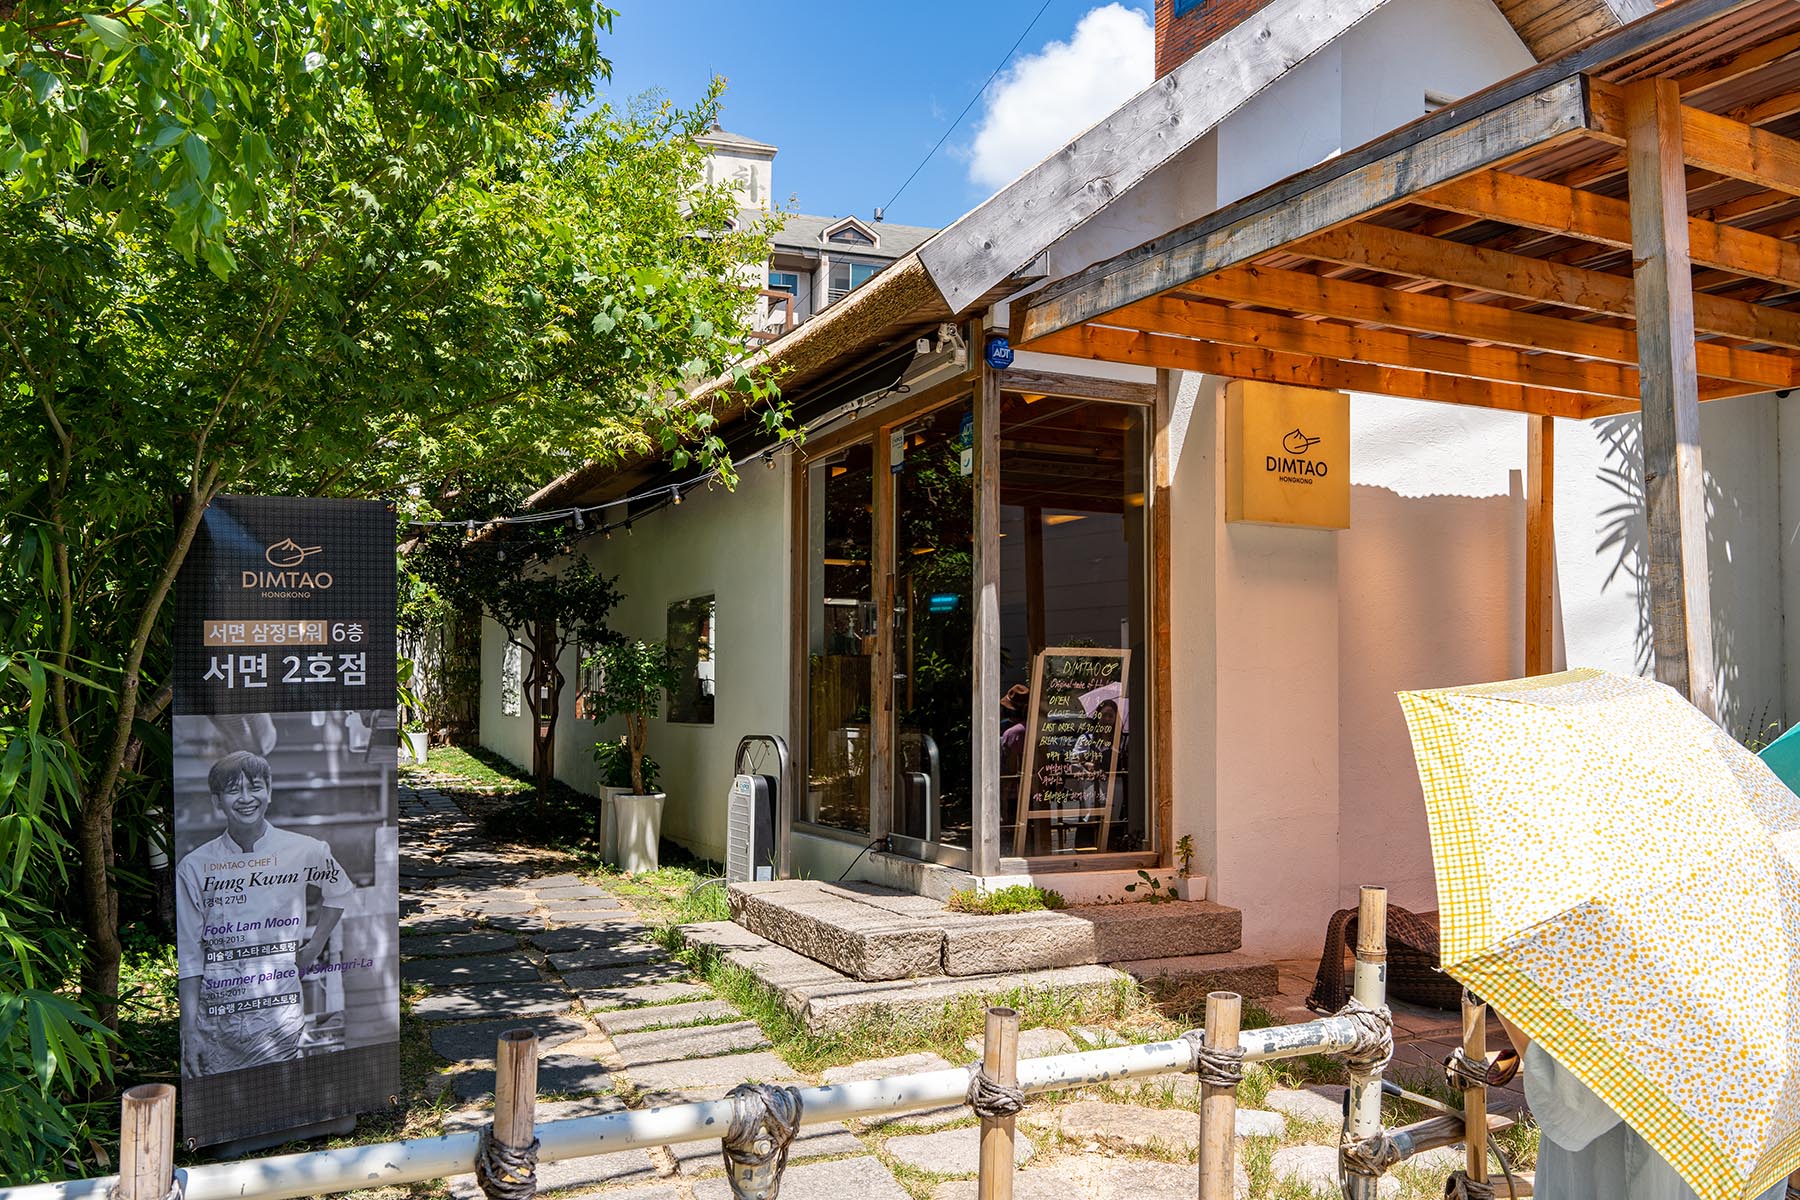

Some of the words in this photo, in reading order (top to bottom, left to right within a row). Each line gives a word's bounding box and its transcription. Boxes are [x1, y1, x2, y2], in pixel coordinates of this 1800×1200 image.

[993, 347, 1010, 359] ADT
[1266, 455, 1328, 477] DIMTAO
[1279, 476, 1313, 485] HONGKONG
[242, 571, 334, 589] DIMTAO
[261, 591, 311, 599] HONGKONG
[209, 623, 246, 643] 서면
[252, 623, 323, 643] 삼정타워
[332, 622, 364, 642] 6층
[202, 653, 268, 689] 서면
[281, 652, 367, 686] 2호점
[1062, 660, 1101, 677] DIMTAO
[1041, 722, 1056, 732] LAST
[1057, 722, 1075, 732] ORDER
[1039, 735, 1058, 747] BREAK
[210, 860, 246, 871] DIMTAO
[247, 858, 272, 868] CHEF
[203, 876, 245, 893] Fung
[248, 872, 299, 888] Kwun
[303, 866, 340, 883] Tong
[225, 894, 247, 905] 27년)
[204, 922, 234, 936] Fook
[236, 920, 262, 932] Lam
[264, 916, 300, 929] Moon
[236, 946, 260, 957] 1스타
[261, 941, 297, 955] 레스토랑
[205, 974, 256, 990] Summer
[257, 968, 296, 984] palace
[298, 967, 311, 978] at
[313, 957, 373, 975] Shangri-La
[205, 988, 247, 1000] 2015-2017
[237, 999, 261, 1011] 2스타
[262, 994, 298, 1007] 레스토랑
